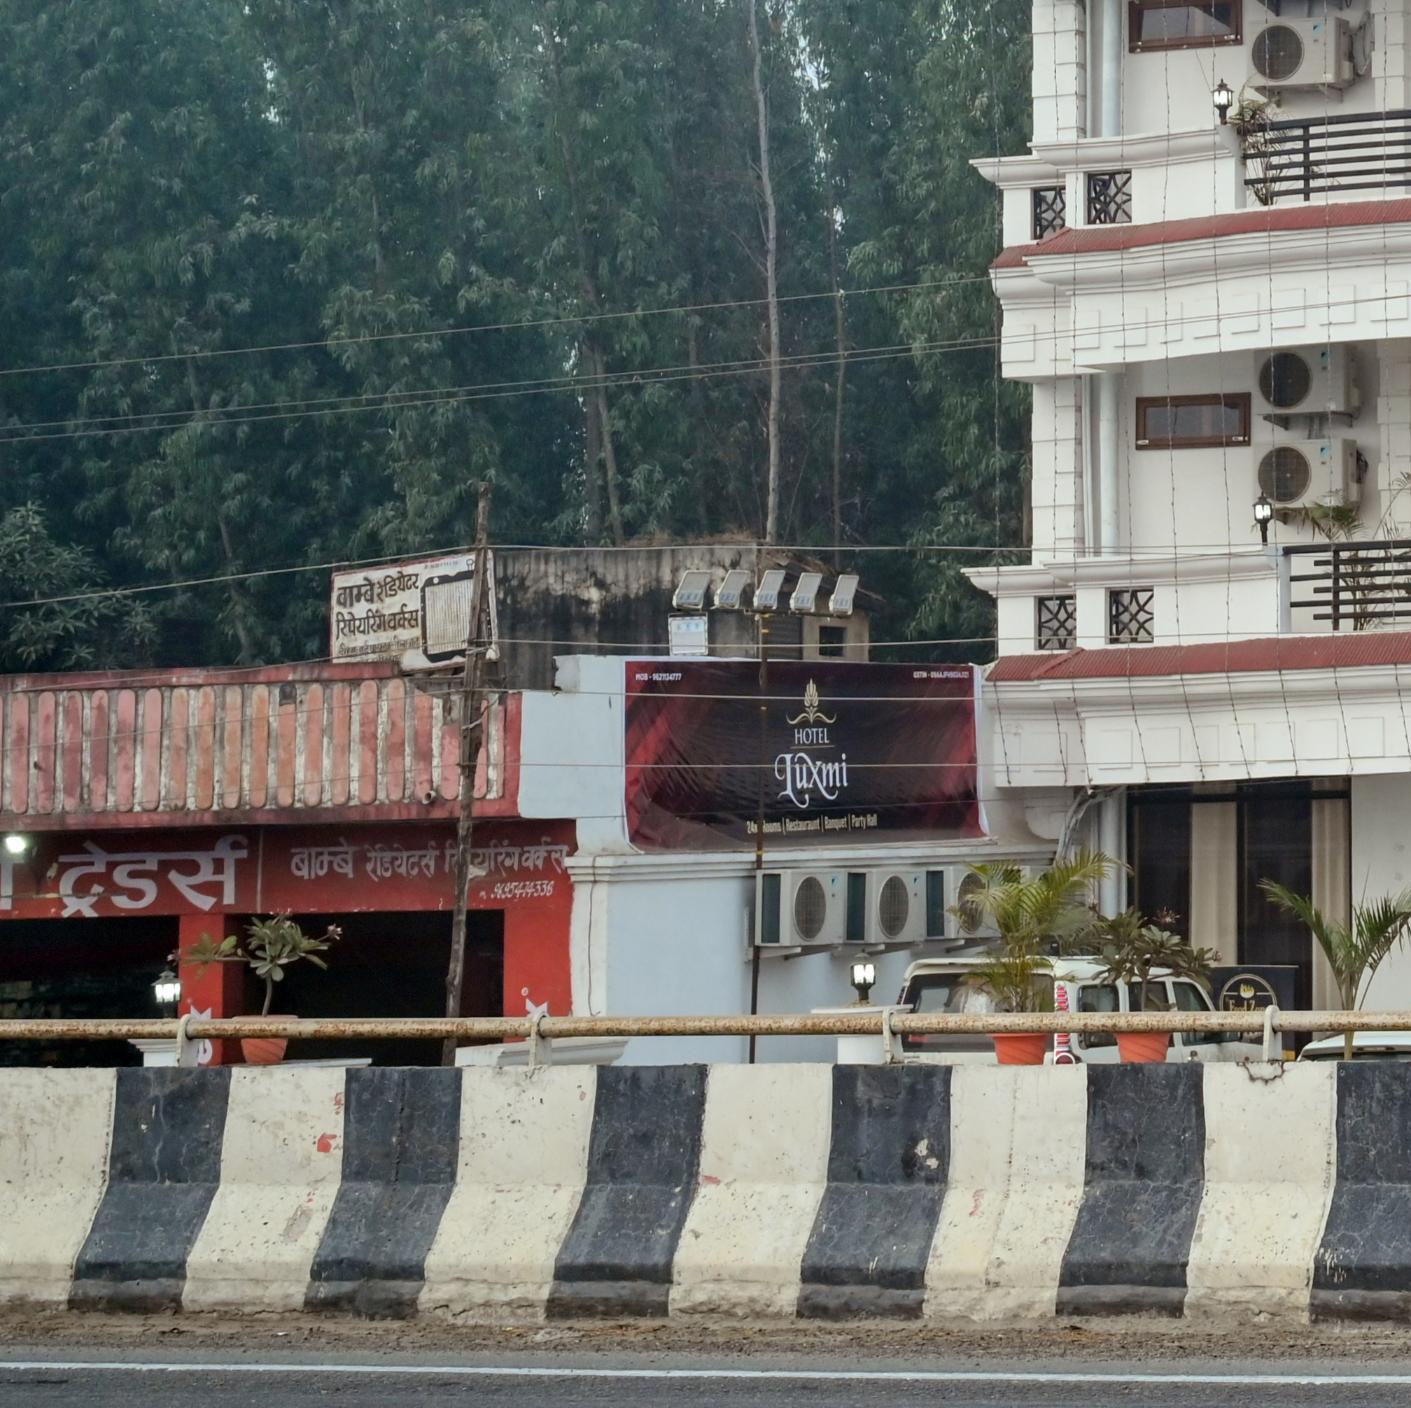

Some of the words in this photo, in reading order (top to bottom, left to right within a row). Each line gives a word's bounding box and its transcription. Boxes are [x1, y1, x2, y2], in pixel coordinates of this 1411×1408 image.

[794, 728, 830, 744] HOTEL
[774, 752, 849, 808] Luxmi
[58, 834, 248, 917] ट्रेडर्स
